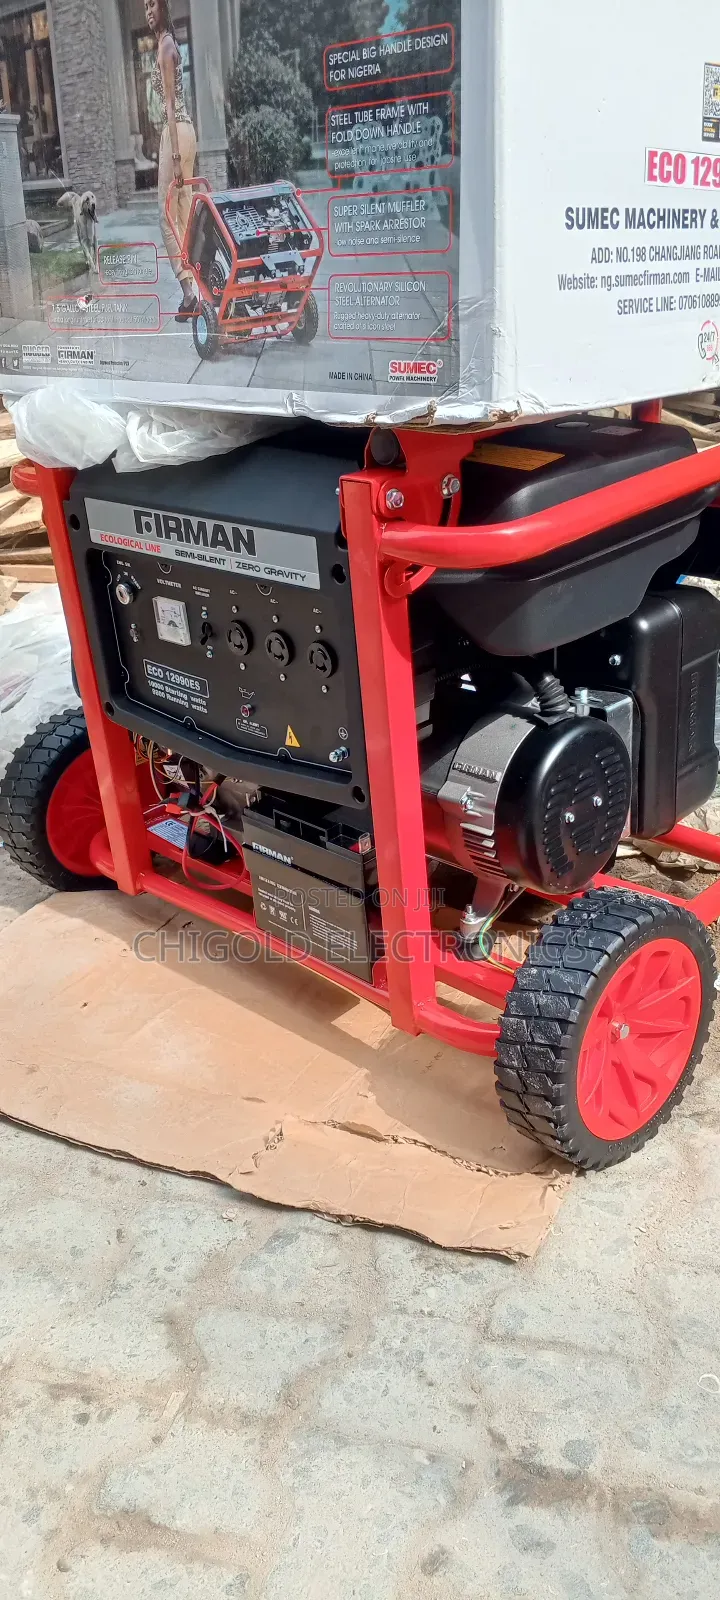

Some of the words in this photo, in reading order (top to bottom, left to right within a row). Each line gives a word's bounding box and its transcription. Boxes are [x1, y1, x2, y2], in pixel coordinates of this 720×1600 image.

[328, 50, 360, 66] SPECIAL
[362, 46, 377, 60] BIG
[379, 38, 413, 56] HANDLE
[414, 33, 448, 50] DESIGN
[329, 69, 346, 82] FOR
[348, 63, 381, 79] NIGERIA
[330, 113, 352, 127] STEEL
[354, 110, 373, 124] TUBE
[375, 105, 405, 121] FRAME
[407, 101, 429, 116] WITH
[331, 130, 353, 144] FOLD
[355, 126, 384, 140] DOWN
[386, 121, 422, 136] HANDLE
[418, 137, 434, 148] and
[334, 158, 367, 171] protection
[368, 156, 377, 166] for
[403, 153, 417, 163] use
[647, 150, 687, 185] ECO
[333, 204, 358, 217] SUPER
[360, 202, 386, 215] SILENT
[387, 199, 426, 213] MUFFLER
[334, 221, 354, 233] WITH
[355, 219, 381, 232] SPARK
[382, 216, 426, 231] ARRESTOR
[564, 206, 620, 231] SUMEC
[624, 207, 707, 230] MACHINERY
[709, 208, 720, 230] &
[348, 236, 365, 246] noise
[365, 235, 379, 245] and
[380, 233, 421, 245] semi-silence
[103, 254, 126, 265] RELEASE
[590, 247, 613, 264] ADD:
[615, 246, 647, 263] NO.198
[649, 244, 701, 262] CHANGJIANG
[334, 281, 394, 293] REVOLUTIONARY
[395, 280, 426, 292] SILICON
[557, 272, 598, 291] Website:
[600, 270, 690, 291] ng.sumecfirman.com
[61, 303, 84, 313] GALLO
[334, 296, 353, 306] STEEL
[354, 295, 400, 306] ALTERNATOR
[617, 297, 653, 315] SERVICE
[655, 295, 676, 312] LINE:
[678, 293, 720, 310] 070610889
[333, 311, 356, 322] Rugged
[703, 331, 715, 343] 24/7
[58, 350, 94, 360] FIRMAN
[328, 371, 345, 380] MADE
[346, 372, 353, 380] IN
[354, 372, 373, 381] CHINA
[389, 361, 437, 374] SUMEC
[133, 508, 257, 557] FIRMAN
[100, 533, 144, 551] ECOLOGICAL
[145, 543, 161, 554] LINE
[174, 549, 227, 566] SEMI-SILENT
[235, 560, 261, 573] ZERO
[264, 566, 307, 582] GRAVITY
[156, 578, 182, 589] VOLTMETER
[147, 664, 164, 678] ECO
[165, 671, 201, 691] 12990ES
[165, 685, 188, 700] Starting
[189, 695, 207, 706] watts
[166, 693, 189, 708] Running
[190, 703, 208, 714] watts
[251, 841, 292, 865] FIRMAN
